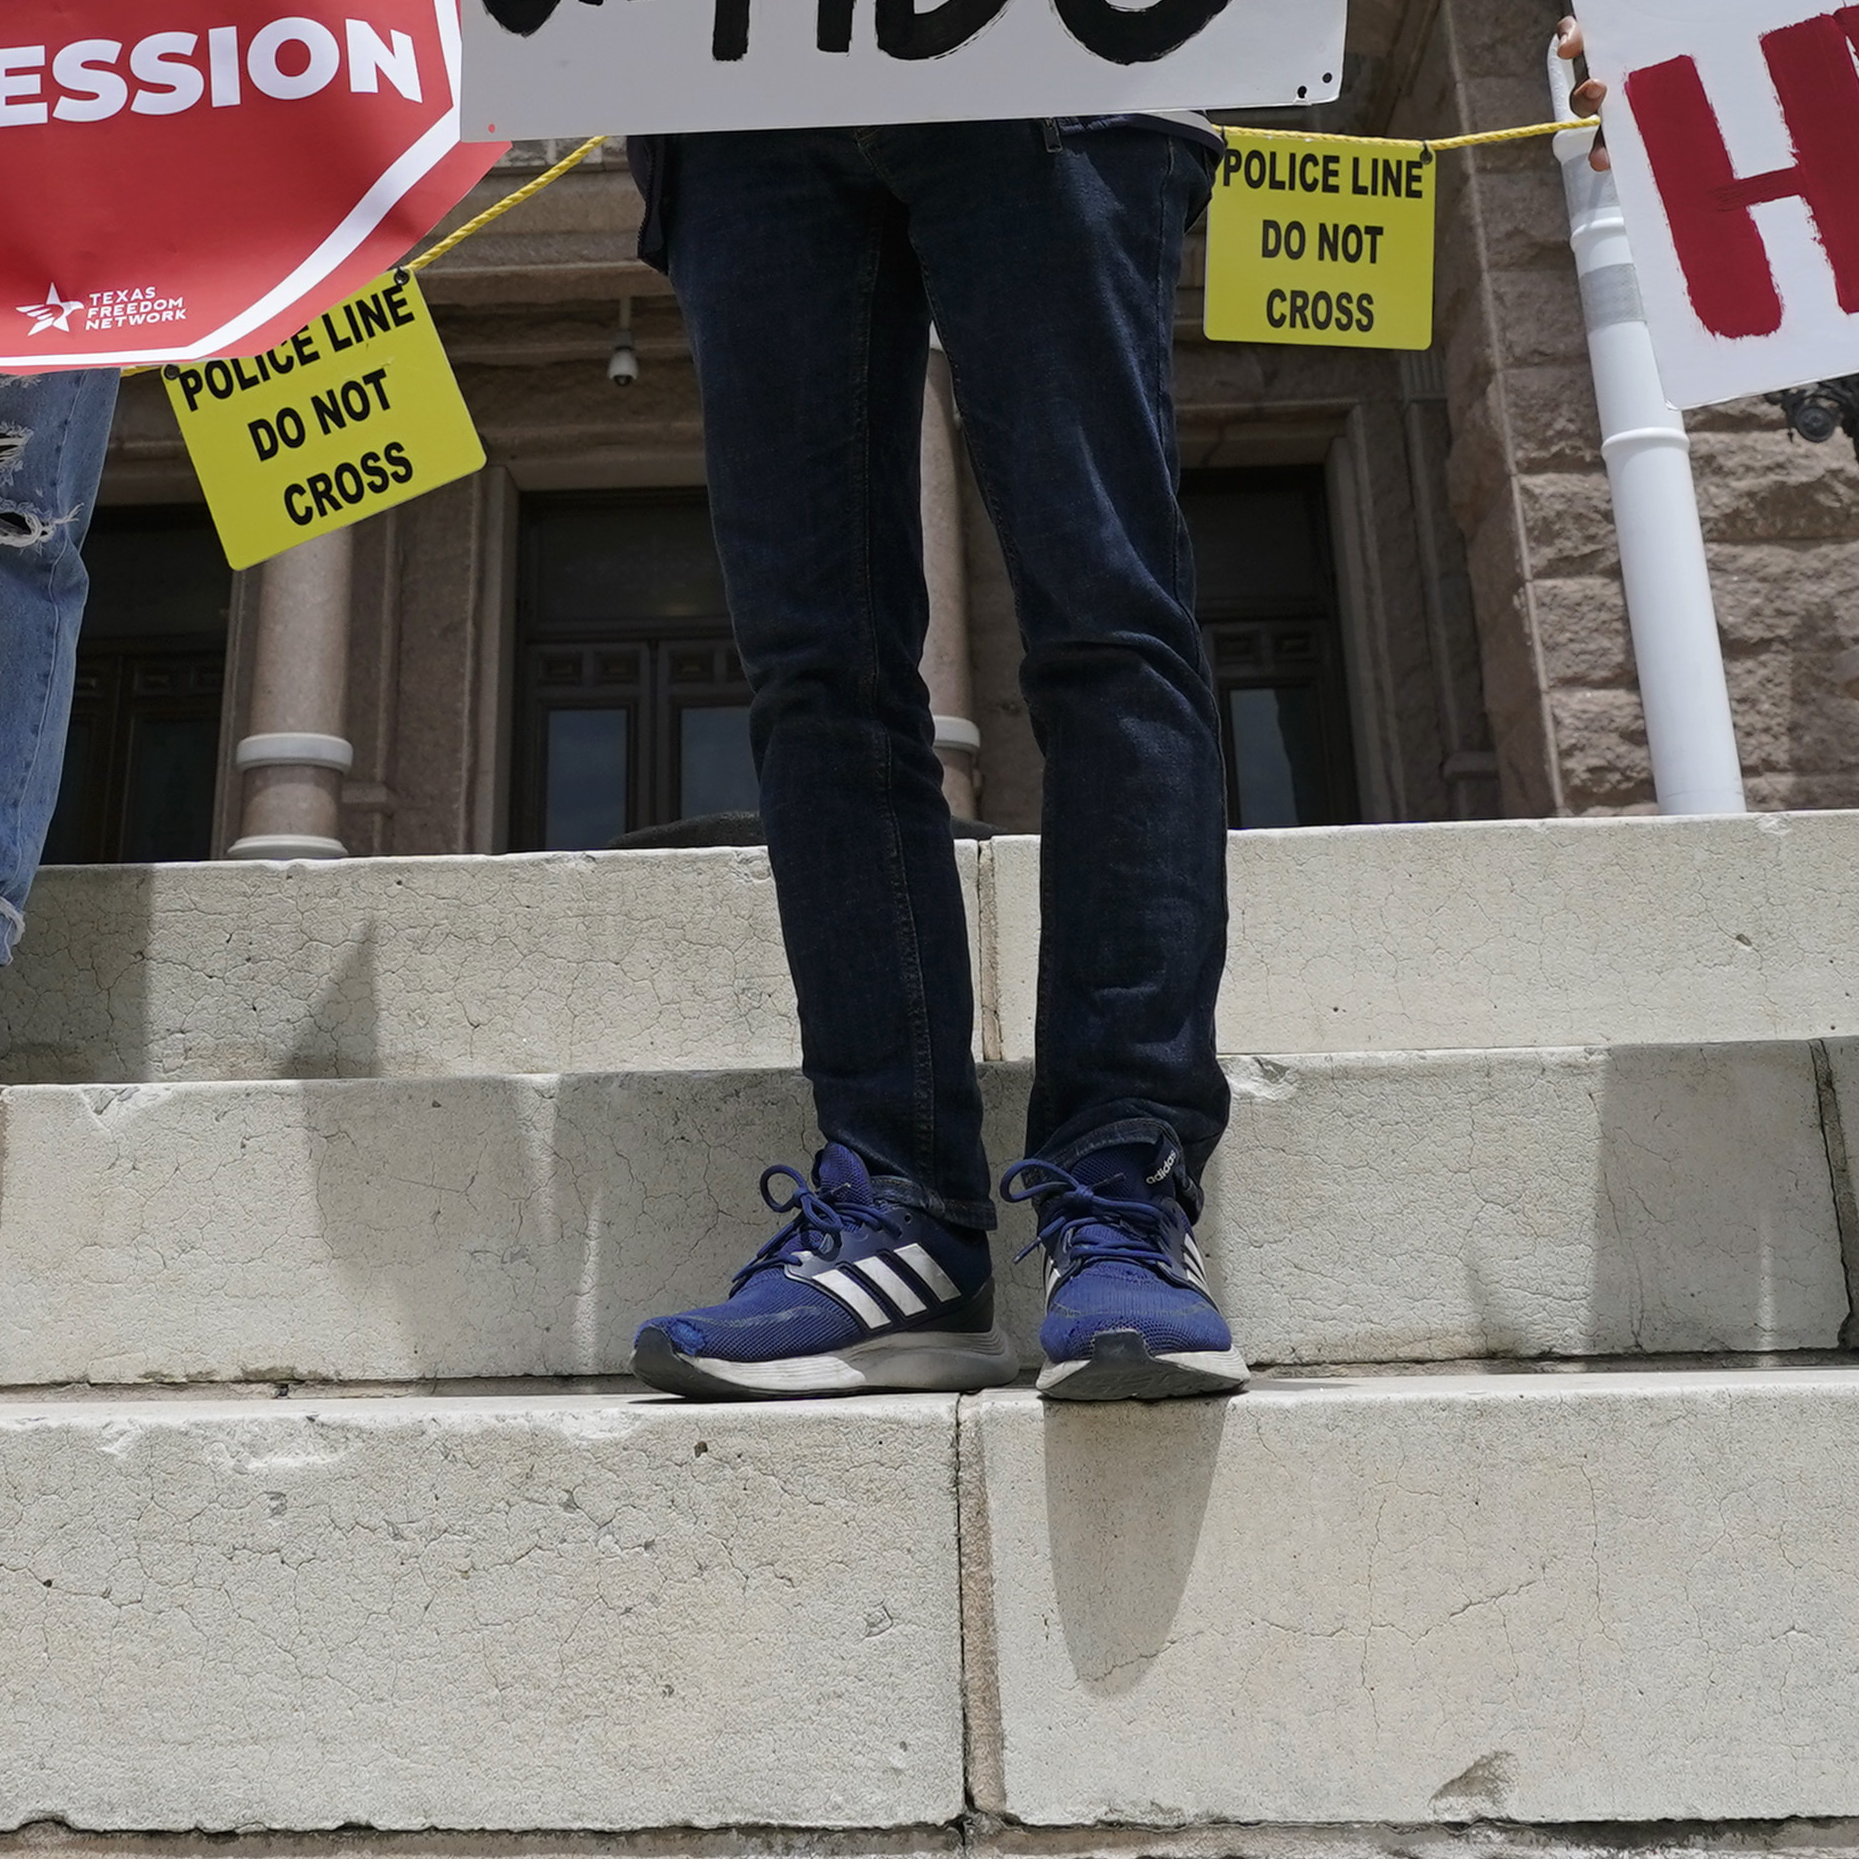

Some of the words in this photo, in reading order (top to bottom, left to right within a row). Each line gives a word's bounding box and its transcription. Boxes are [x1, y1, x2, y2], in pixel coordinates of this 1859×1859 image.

[1222, 148, 1341, 194] POLICE
[1351, 156, 1424, 199] LINE
[1261, 219, 1306, 260] DO
[1318, 222, 1384, 264] NOT
[87, 297, 184, 319] FREEDOM
[89, 286, 157, 307] TEXAS
[1266, 289, 1374, 333] CROSS
[85, 308, 188, 331] NETWORK
[178, 325, 321, 412] POLICE
[321, 284, 415, 353] LINE
[247, 407, 306, 462] DO
[310, 368, 391, 436] NOT
[283, 441, 414, 526] CROSS
[1145, 1149, 1177, 1185] adidas
